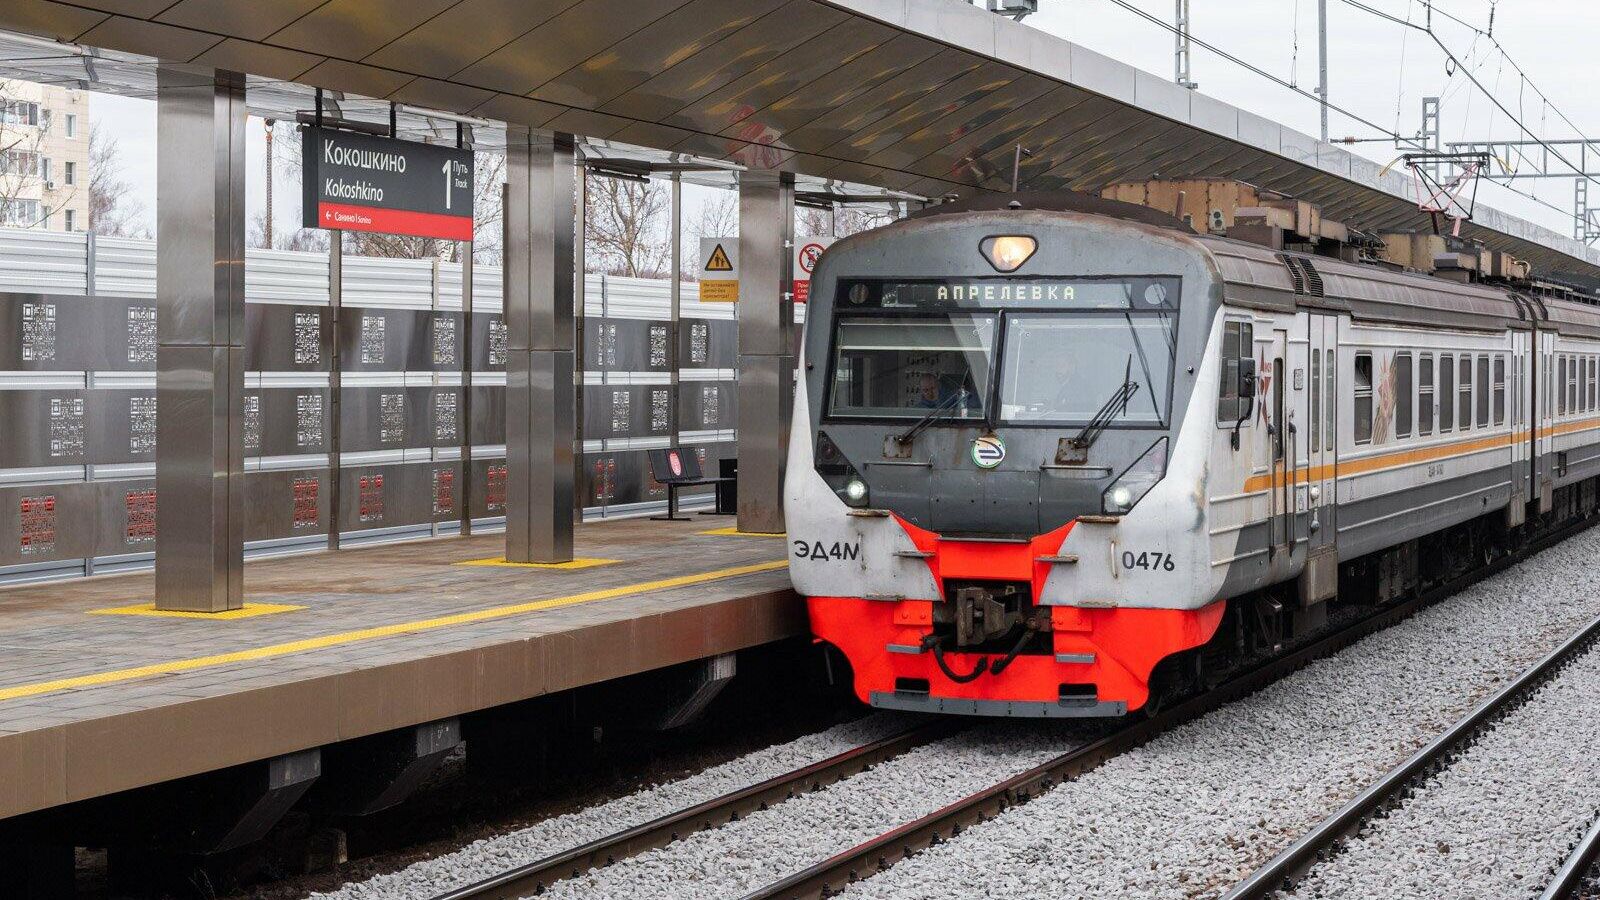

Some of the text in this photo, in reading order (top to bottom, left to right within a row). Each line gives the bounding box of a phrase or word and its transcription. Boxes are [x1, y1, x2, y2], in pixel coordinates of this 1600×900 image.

[325, 139, 406, 173] Кокошкино
[453, 160, 469, 176] Путь
[325, 178, 384, 201] Kokoshkino
[442, 159, 452, 209] 1
[937, 285, 1075, 300] АПРЕЛЕВКА
[793, 540, 860, 562] ЭД4М
[1122, 551, 1175, 572] 0476
